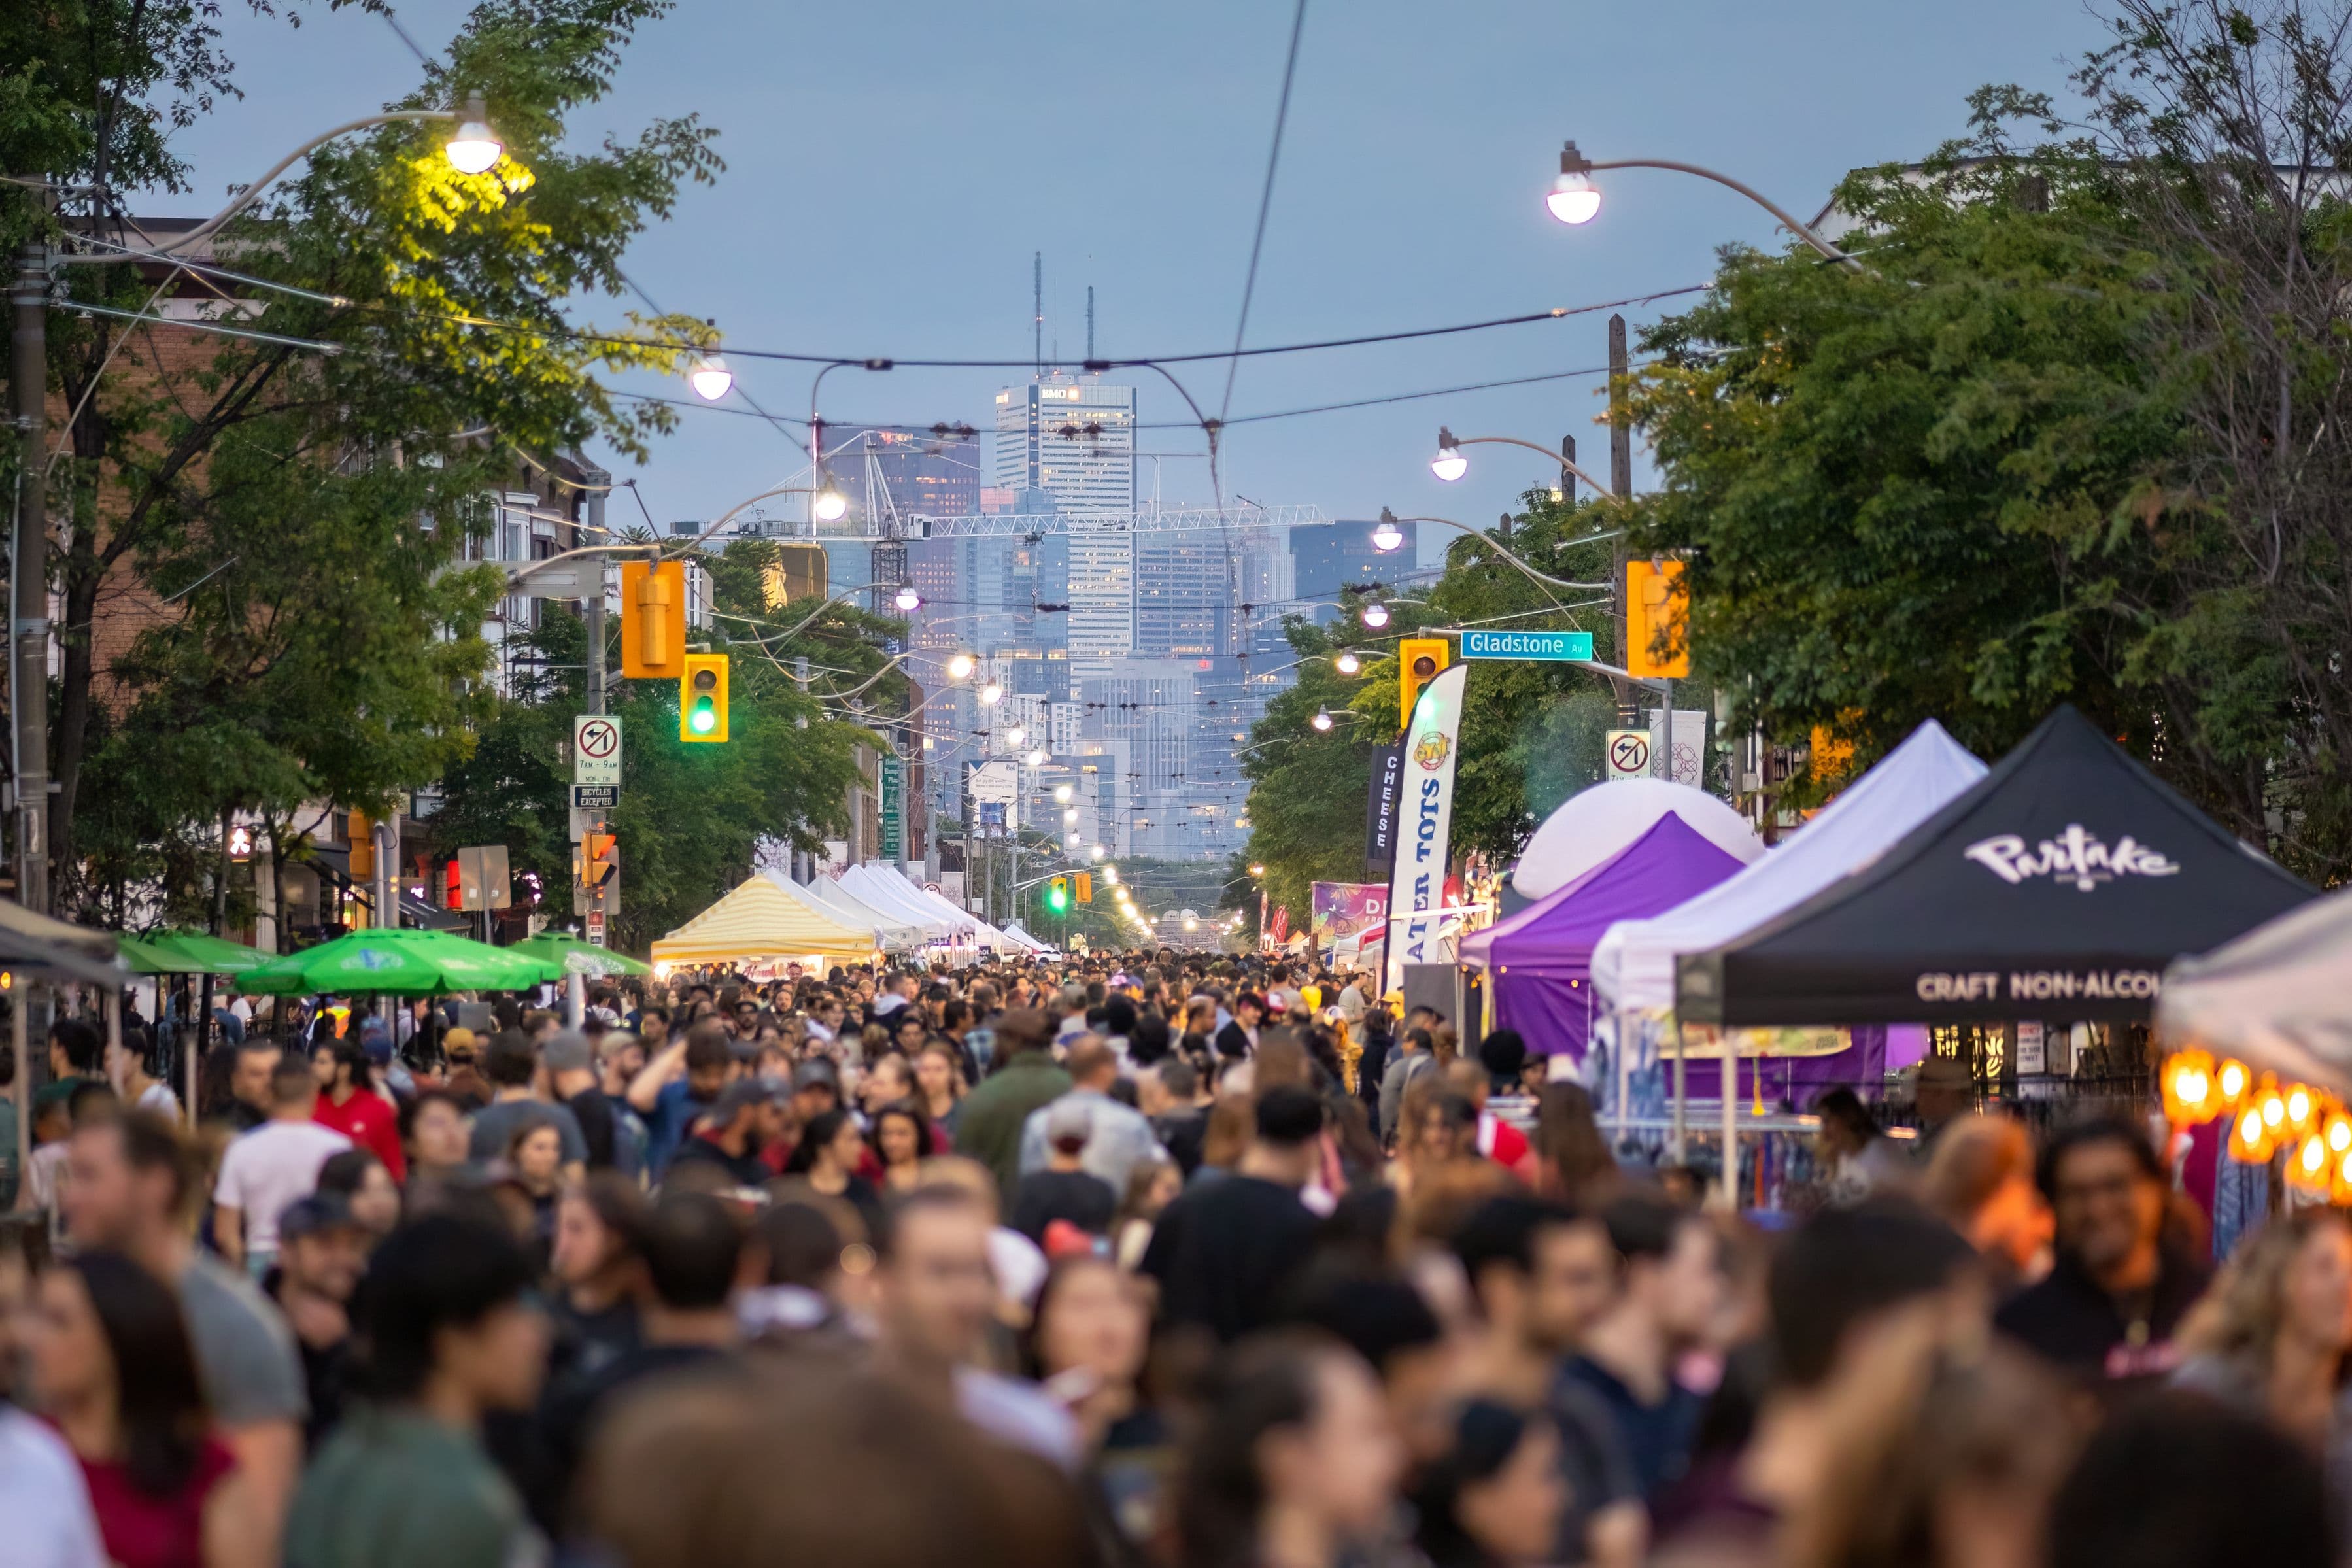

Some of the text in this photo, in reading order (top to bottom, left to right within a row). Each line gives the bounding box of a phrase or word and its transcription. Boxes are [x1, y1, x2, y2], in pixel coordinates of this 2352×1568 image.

[1042, 388, 1066, 399] BMO
[1471, 633, 1582, 654] Gladstone Av
[579, 760, 593, 768] 7AM
[603, 760, 617, 768] 9AM
[581, 787, 611, 796] BICYCLES
[581, 797, 613, 806] EXCEPTED
[1377, 756, 1398, 847] CHEESE
[1416, 779, 1439, 863] TOTS
[1963, 823, 2181, 889] Partake
[1916, 971, 1999, 1002] CRAFT
